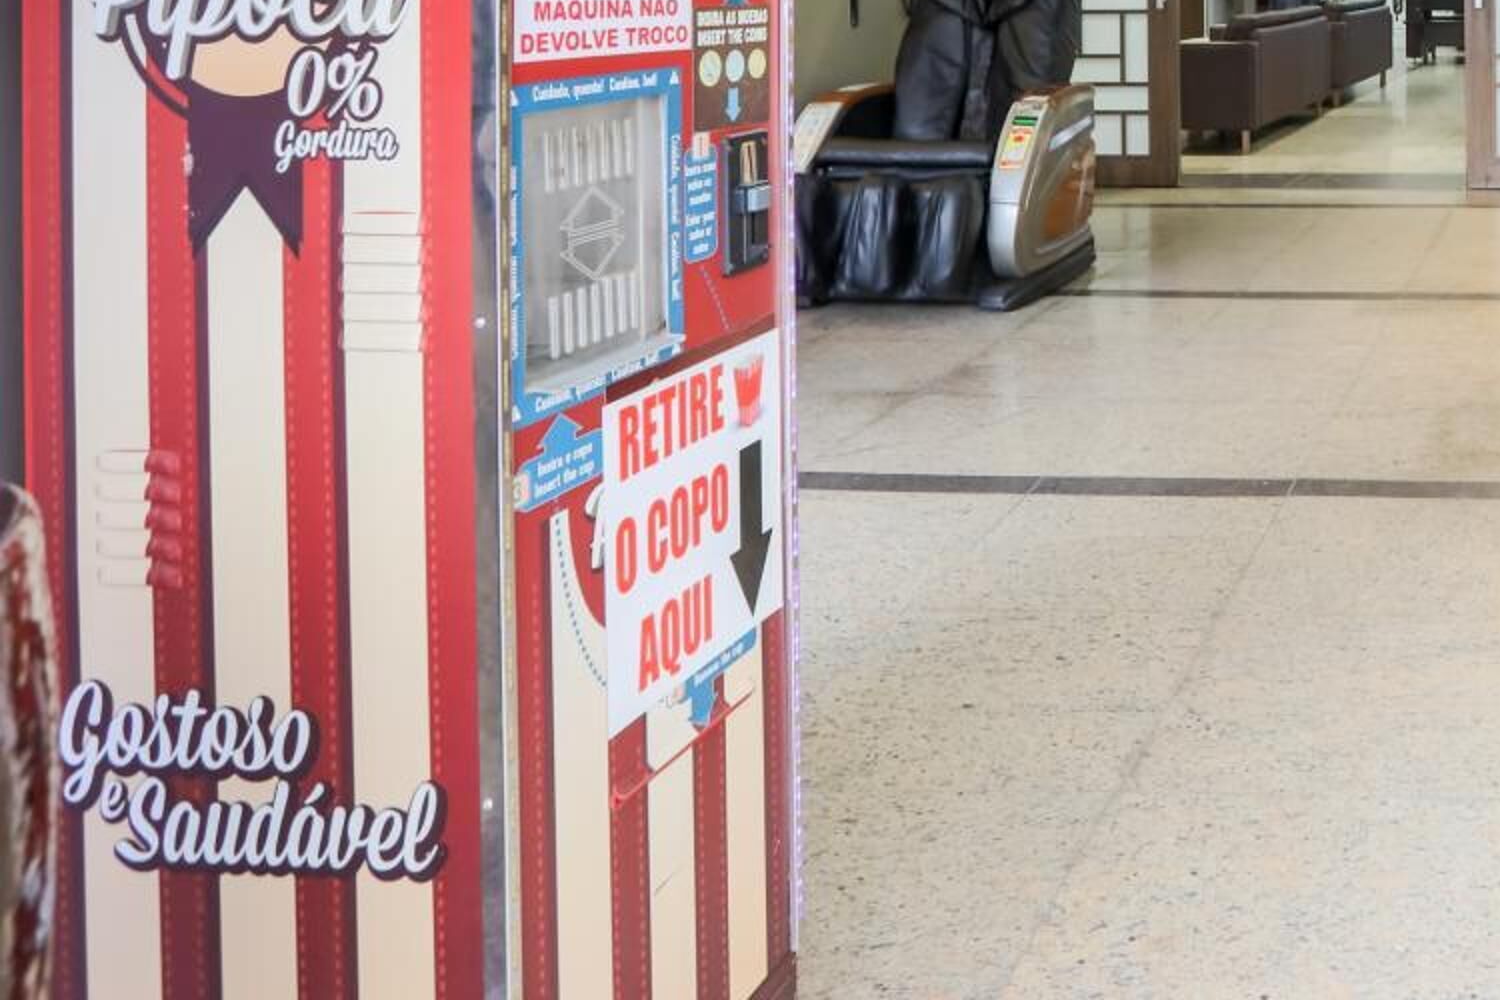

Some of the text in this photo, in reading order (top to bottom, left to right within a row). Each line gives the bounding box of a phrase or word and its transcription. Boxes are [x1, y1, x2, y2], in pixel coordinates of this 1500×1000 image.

[287, 45, 382, 121] 0%
[520, 25, 688, 55] DEVOLVE TROCO
[274, 119, 400, 173] Gordura
[617, 362, 725, 482] RETIRE
[614, 516, 637, 595] O
[647, 462, 729, 575] COPO
[638, 574, 714, 692] AQUI
[58, 679, 314, 805] Gostoso
[100, 776, 443, 875] e Saudável
